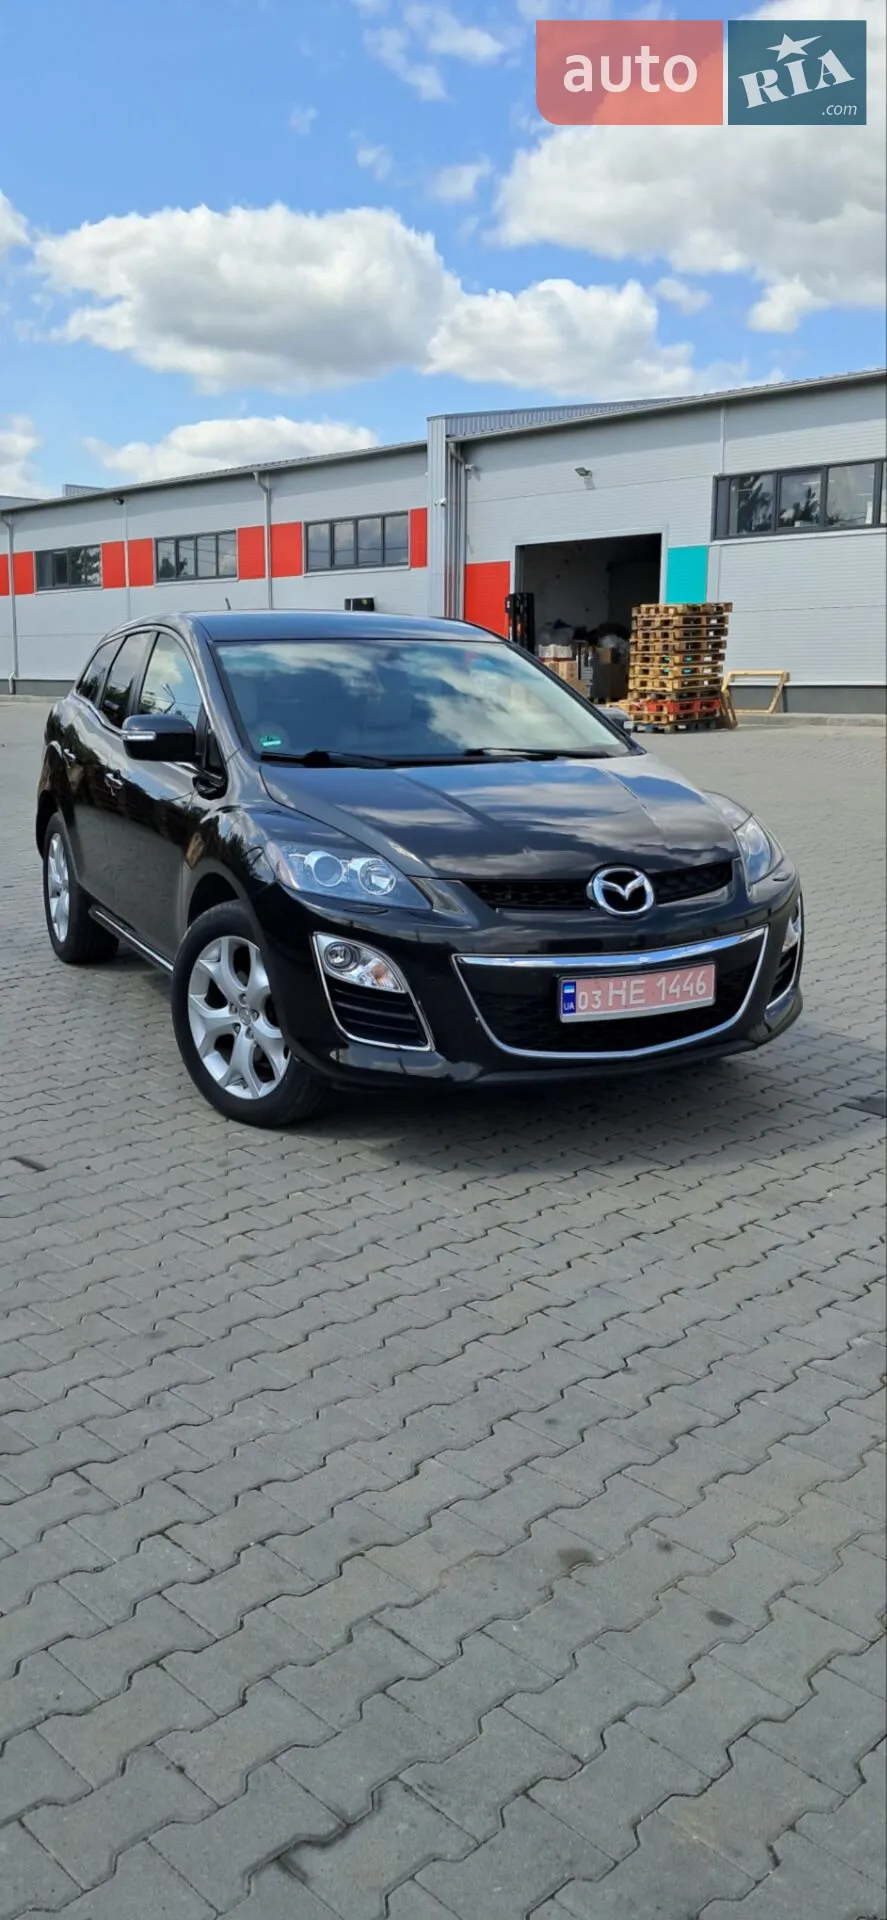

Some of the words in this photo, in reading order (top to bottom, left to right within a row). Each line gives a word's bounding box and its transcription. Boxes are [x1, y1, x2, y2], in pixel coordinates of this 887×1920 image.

[578, 990, 602, 1010] 03
[608, 980, 646, 1006] HE
[656, 971, 707, 1001] 1446
[563, 1002, 575, 1011] UA
